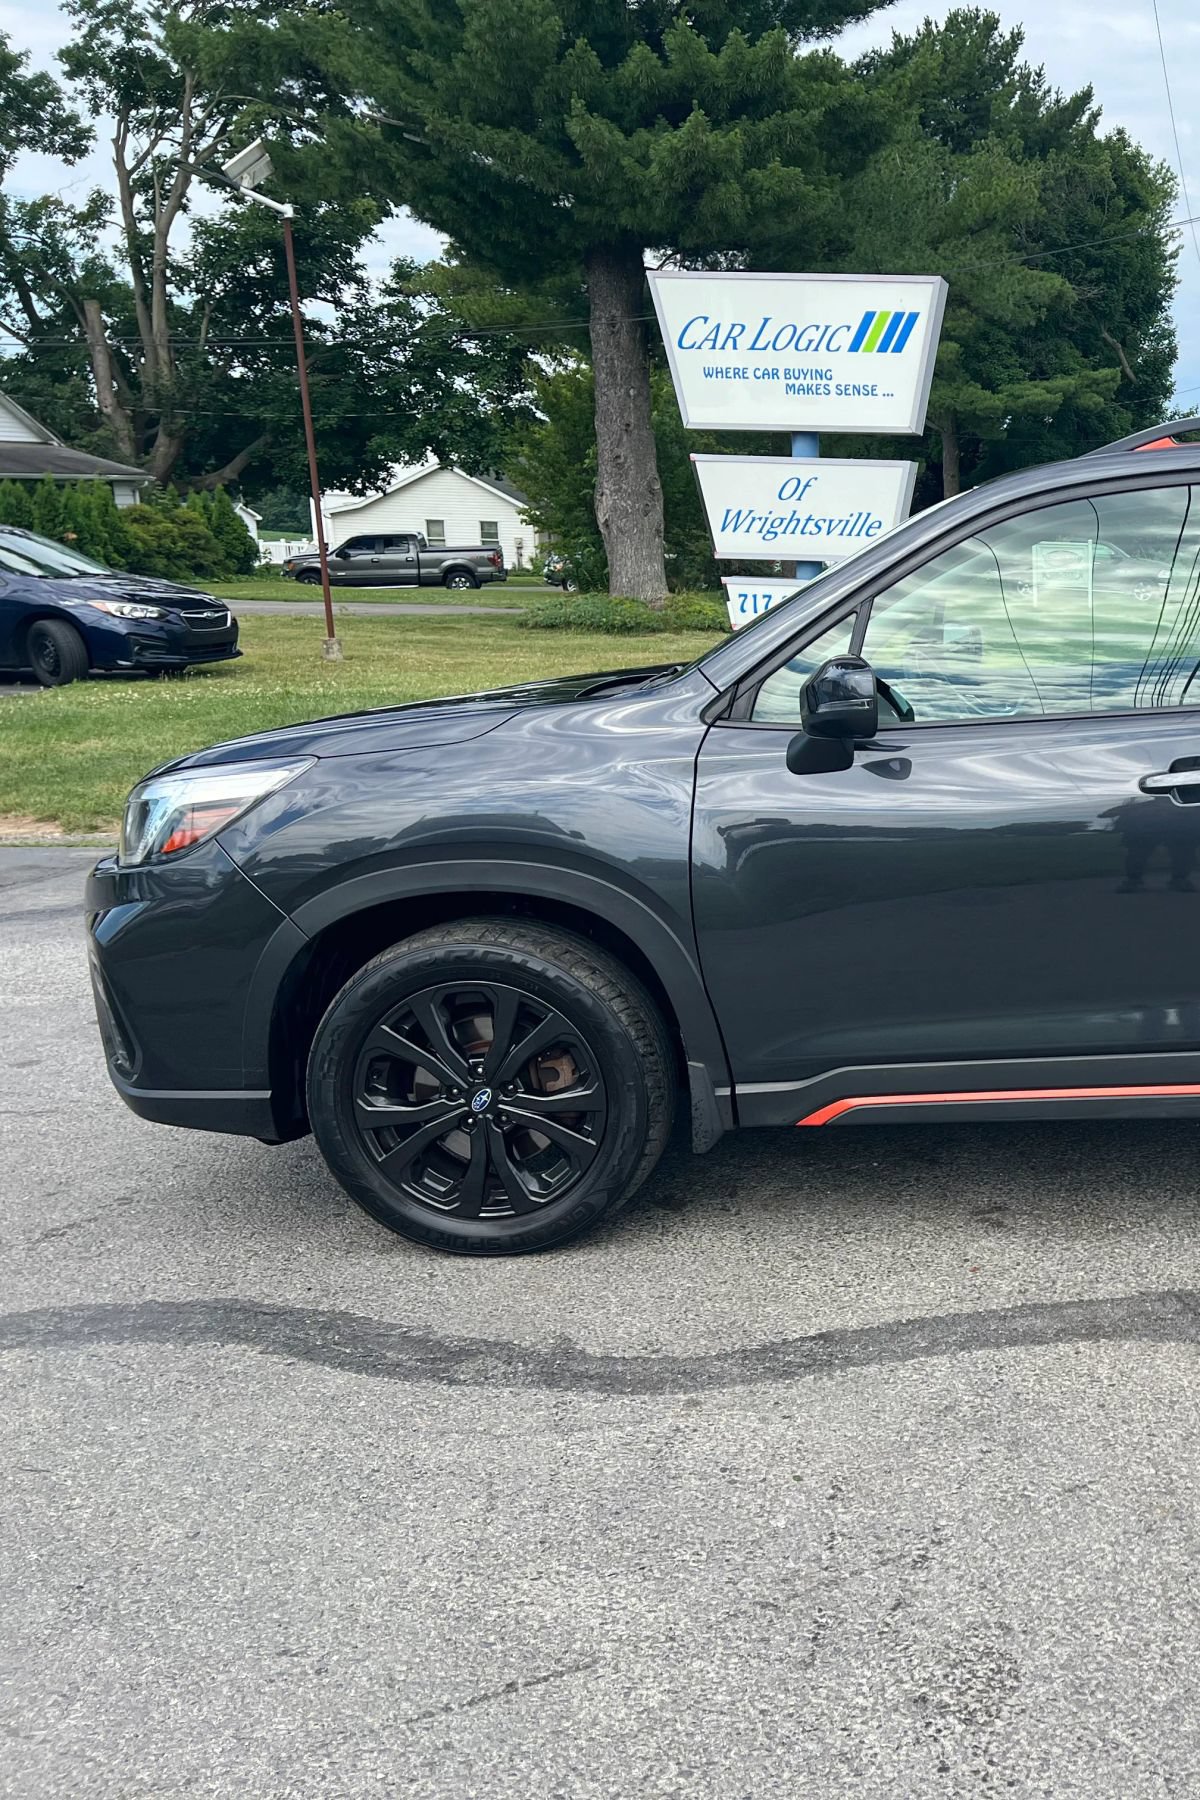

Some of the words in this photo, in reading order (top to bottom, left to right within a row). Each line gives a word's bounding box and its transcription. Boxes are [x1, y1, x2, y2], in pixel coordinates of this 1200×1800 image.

[677, 316, 746, 350] CAR
[747, 317, 850, 352] LOGIC
[703, 366, 749, 379] WHERE
[753, 367, 780, 380] CAR
[784, 368, 833, 381] BUYING
[785, 383, 831, 396] MAKES
[835, 384, 878, 397] SENSE
[777, 477, 818, 501] Of
[720, 508, 883, 541] Wrightsville
[738, 593, 772, 614] 717
